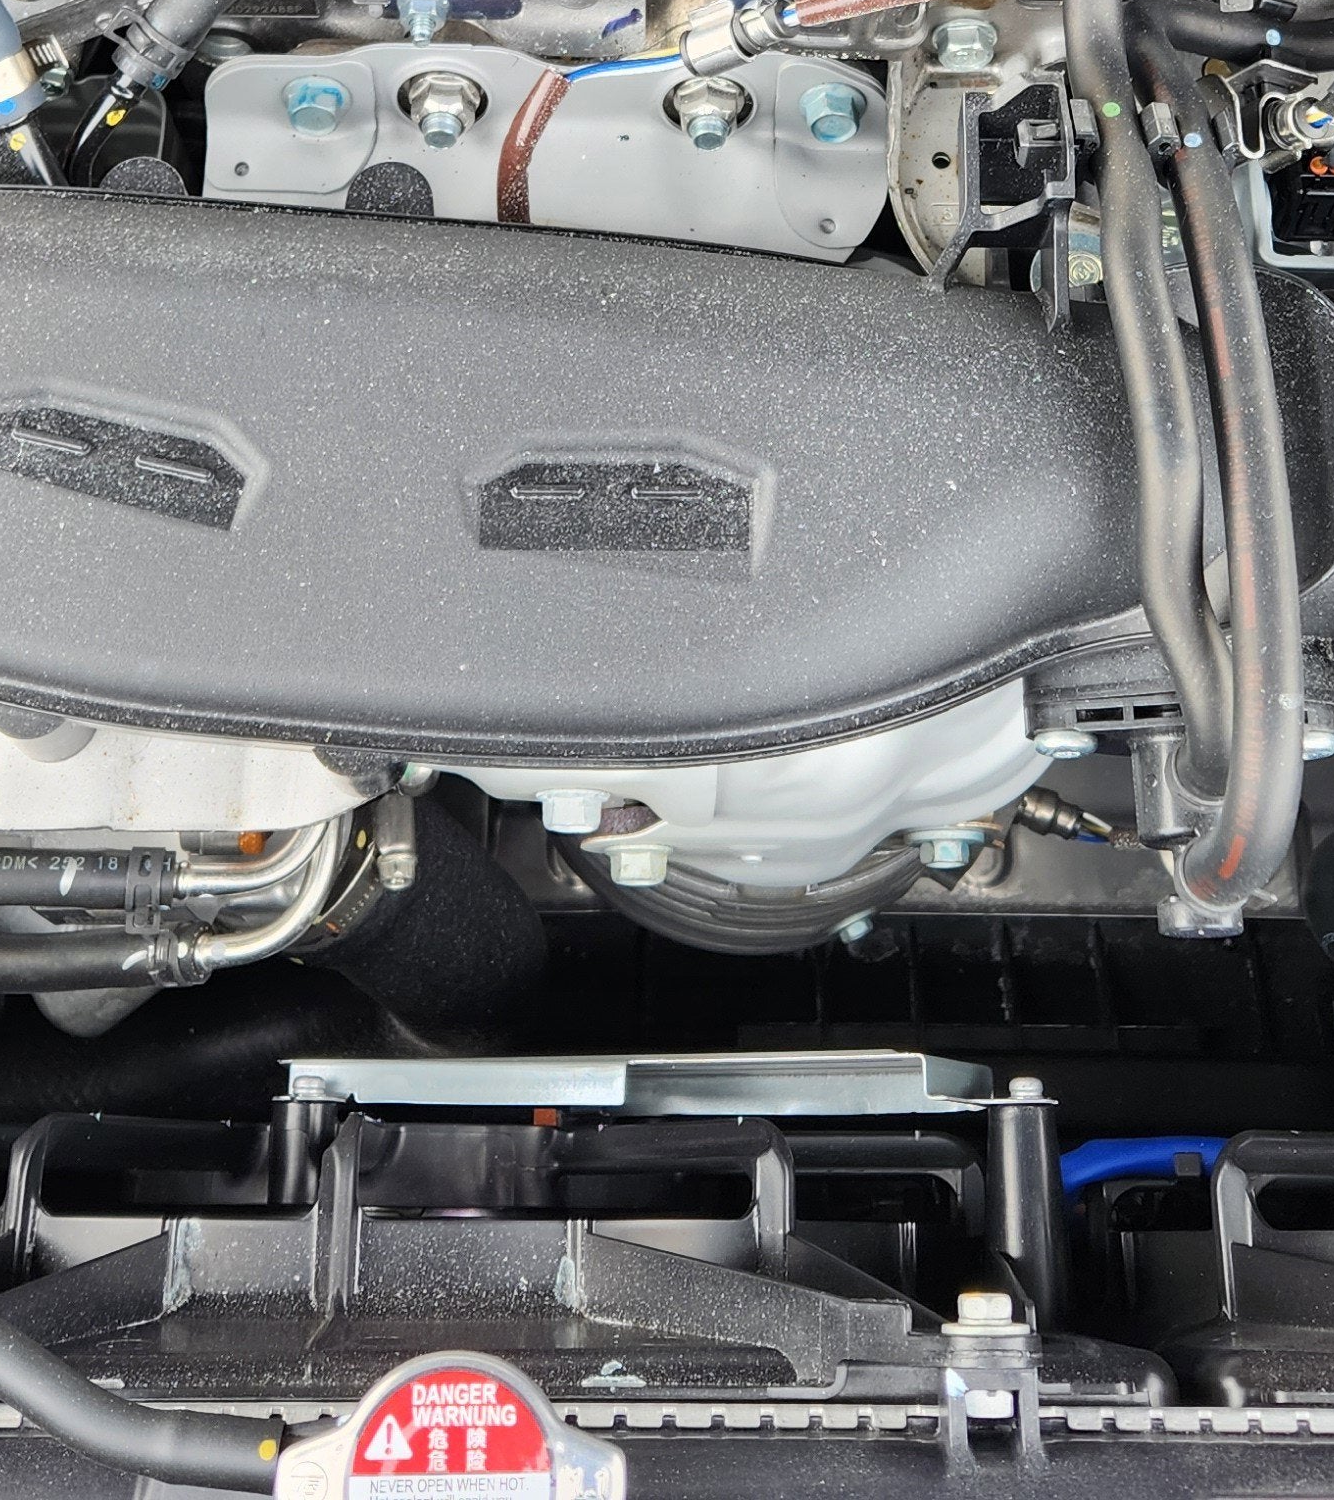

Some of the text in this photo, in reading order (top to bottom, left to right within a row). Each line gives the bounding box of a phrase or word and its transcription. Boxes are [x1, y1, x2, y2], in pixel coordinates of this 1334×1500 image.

[412, 1383, 497, 1406] DANGER
[412, 1405, 518, 1427] WARNUNG
[426, 1428, 449, 1450] 危
[426, 1450, 449, 1473] 危
[369, 1476, 530, 1494] NEVER OPEN WHEN HOT.
